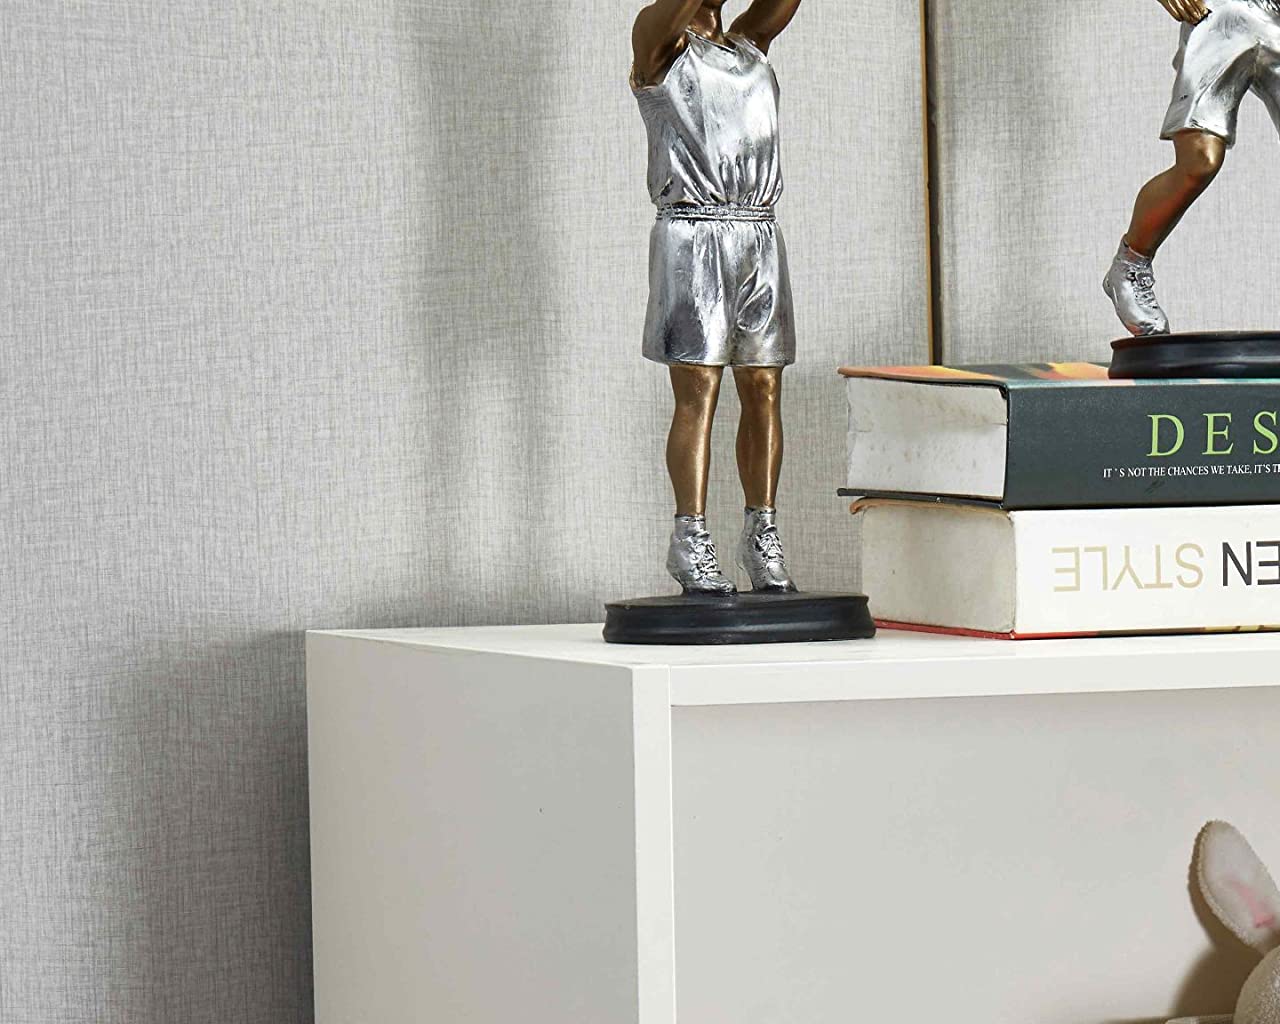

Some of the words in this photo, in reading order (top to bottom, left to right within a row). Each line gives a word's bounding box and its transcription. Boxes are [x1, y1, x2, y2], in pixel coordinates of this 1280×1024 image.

[1127, 467, 1147, 477] NOT
[1149, 466, 1166, 477] THE
[1167, 465, 1209, 477] CHANCES
[1210, 465, 1225, 475] WE
[1051, 542, 1204, 593] STYLE
